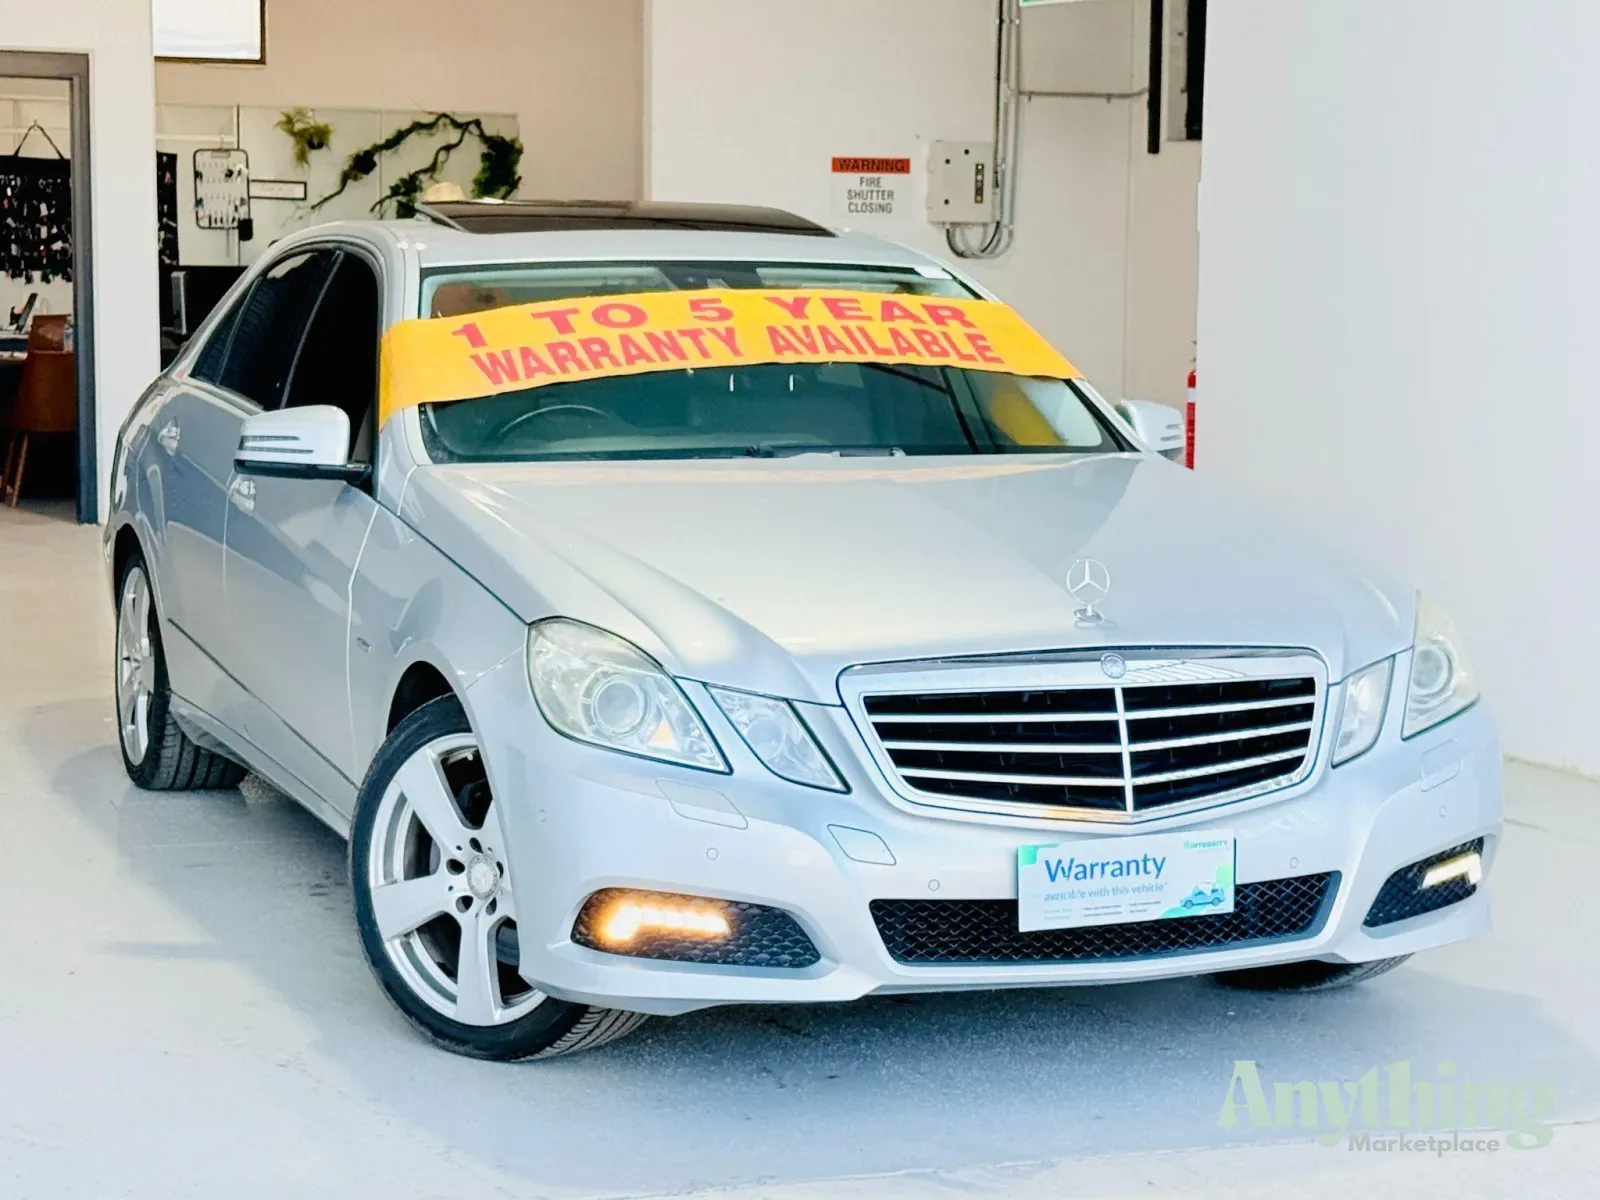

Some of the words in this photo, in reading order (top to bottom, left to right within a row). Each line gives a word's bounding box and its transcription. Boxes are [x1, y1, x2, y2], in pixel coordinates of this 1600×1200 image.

[838, 158, 905, 172] WARNING
[859, 176, 883, 188] FIRE
[846, 189, 894, 201] SHUTTER
[847, 202, 893, 214] CLOSING
[451, 322, 488, 349] 1
[531, 303, 648, 335] TO
[688, 298, 734, 322] 5
[764, 296, 978, 329] YEAR
[469, 326, 744, 386] WARRANTY
[766, 325, 1005, 365] AVAILABLE
[1044, 853, 1166, 882] Warranty
[1088, 886, 1111, 898] with
[1112, 884, 1130, 896] this
